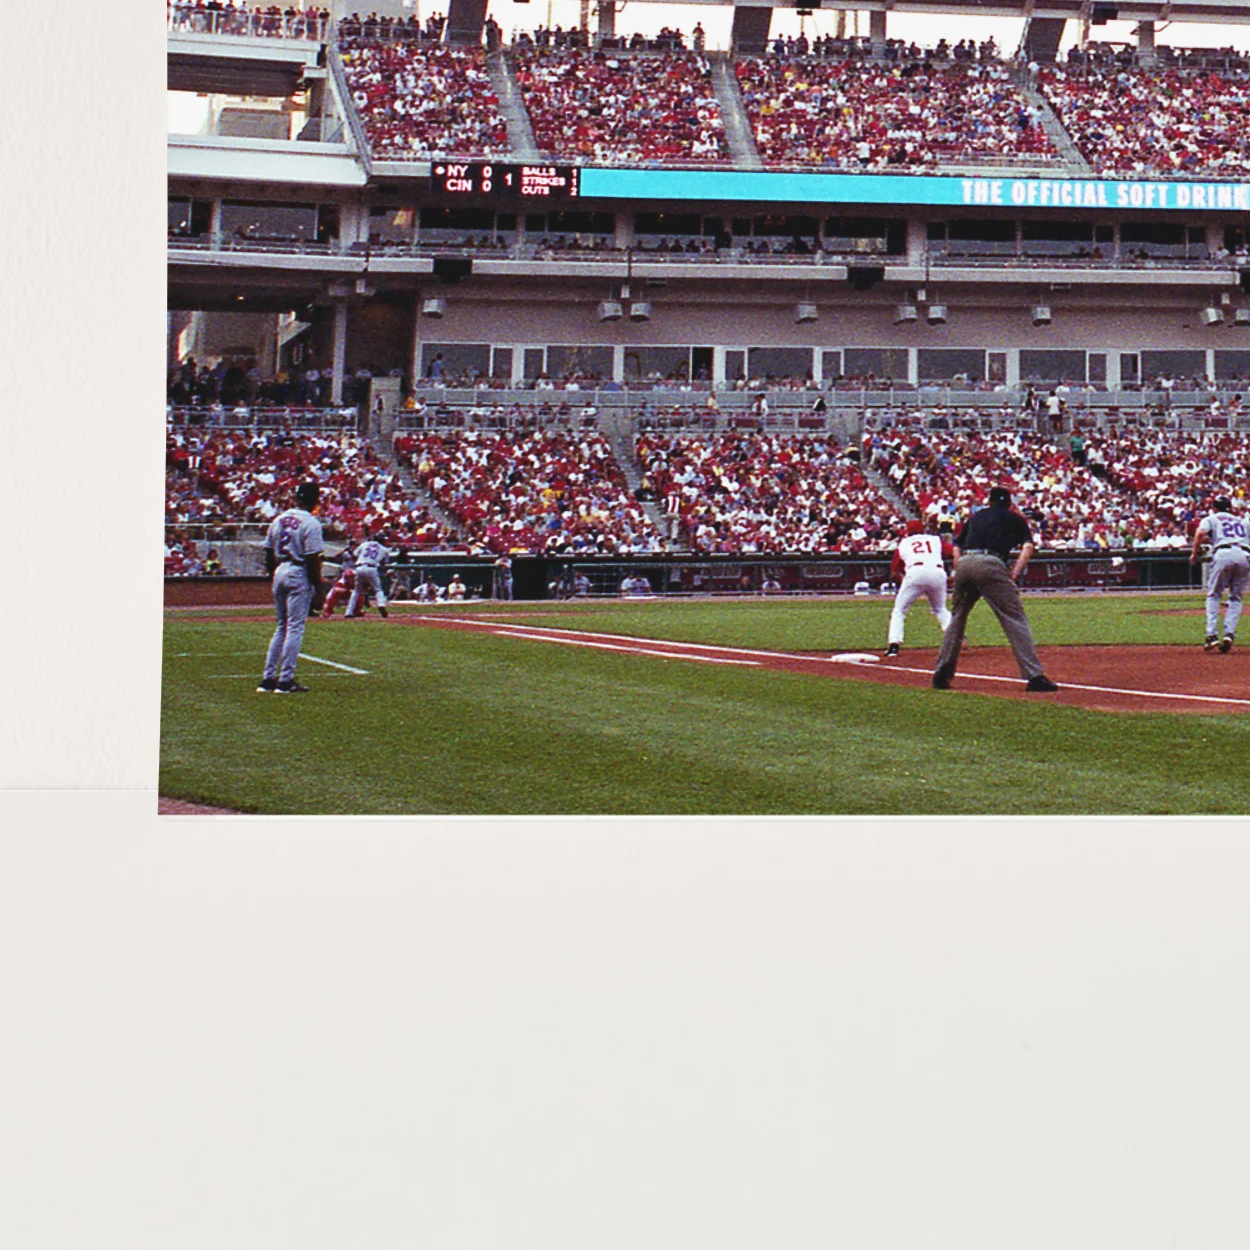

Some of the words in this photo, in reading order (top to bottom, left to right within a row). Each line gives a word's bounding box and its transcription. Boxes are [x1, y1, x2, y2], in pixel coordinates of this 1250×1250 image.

[446, 165, 468, 177] NY
[482, 166, 492, 178] 0
[522, 166, 556, 176] BALLS
[446, 179, 472, 191] CIN
[481, 180, 492, 192] 0
[505, 173, 513, 186] 1
[522, 176, 566, 186] STRIKES
[521, 186, 549, 195] OUTS
[570, 187, 577, 196] 2
[962, 180, 1003, 204] THE
[1012, 182, 1107, 207] OFFICIAL
[1117, 183, 1169, 208] SOFT
[1176, 184, 1249, 210] DRINK
[1222, 521, 1246, 537] 20
[912, 540, 932, 554] 21
